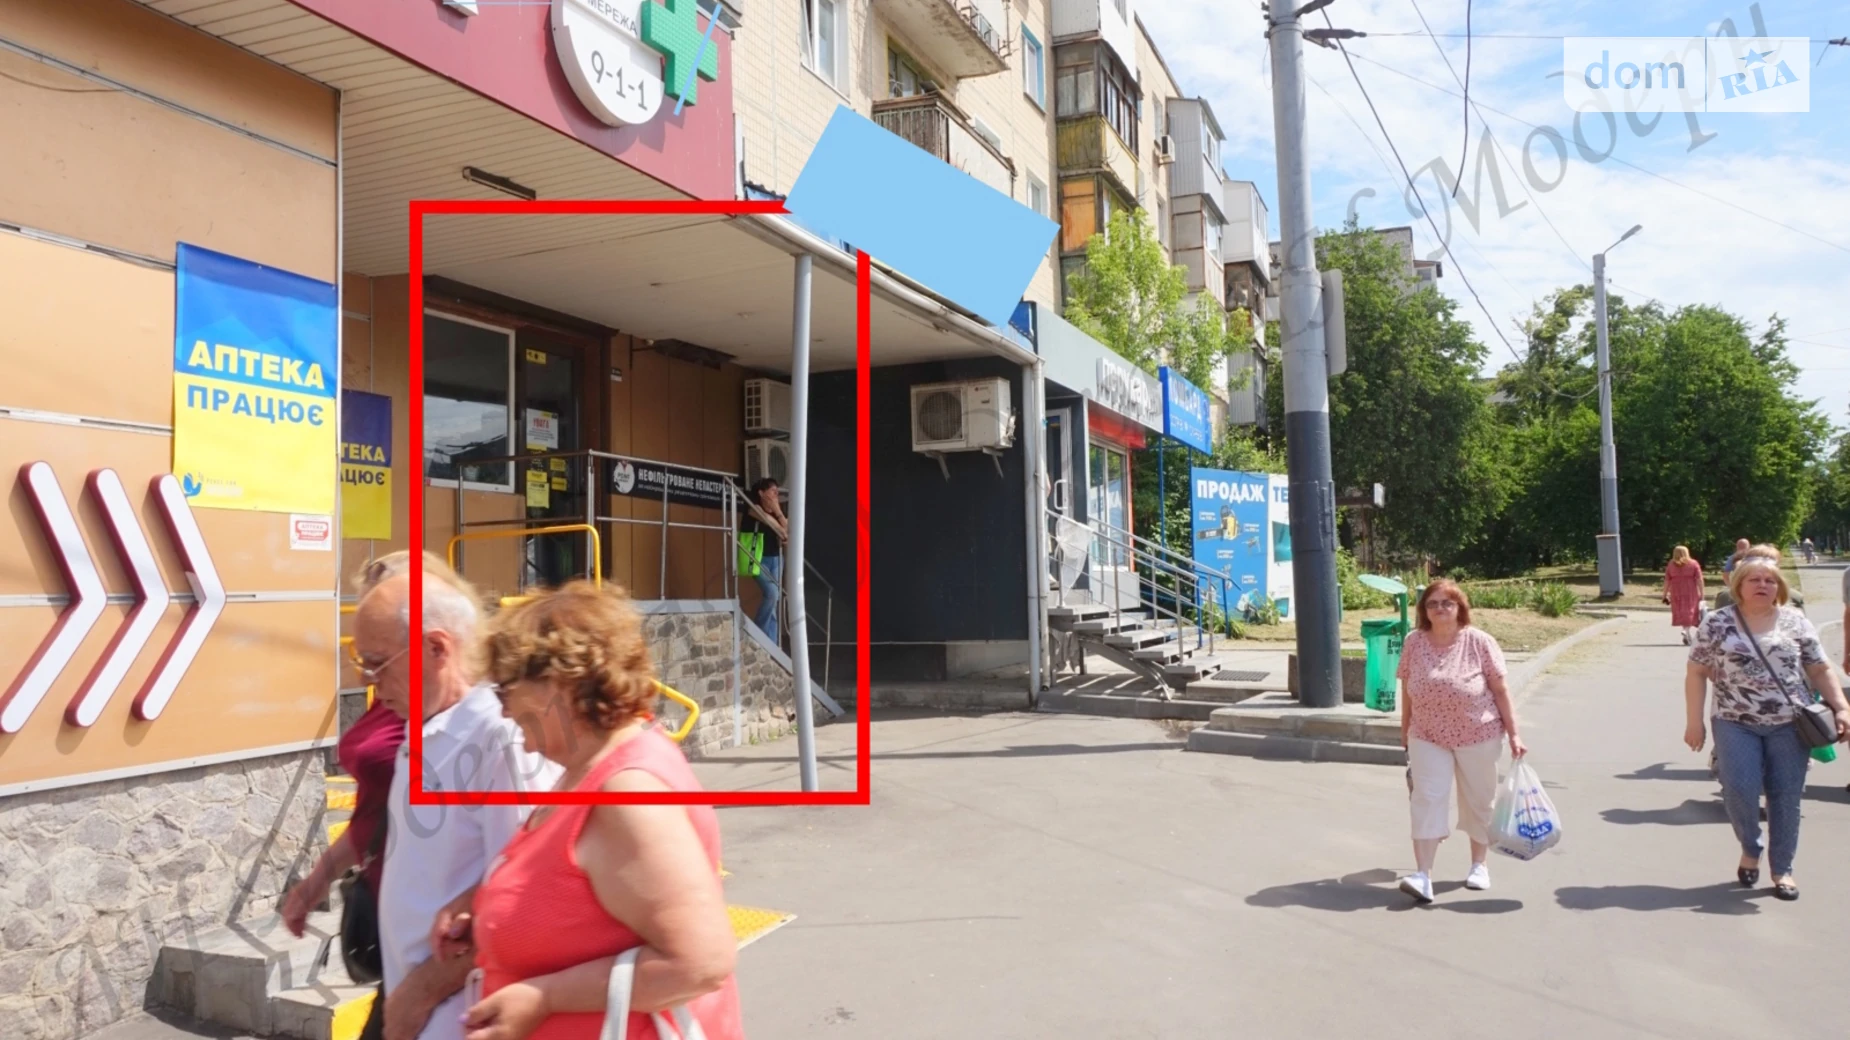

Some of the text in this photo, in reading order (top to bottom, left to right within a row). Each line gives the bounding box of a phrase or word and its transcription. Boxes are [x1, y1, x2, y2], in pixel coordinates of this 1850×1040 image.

[591, 50, 648, 112] 9-1-1
[187, 339, 325, 390] АПТЕКА
[187, 384, 324, 426] ПРАЦЮЄ
[1196, 479, 1266, 504] ПРОДАЖ
[1272, 486, 1289, 503] ТЕ
